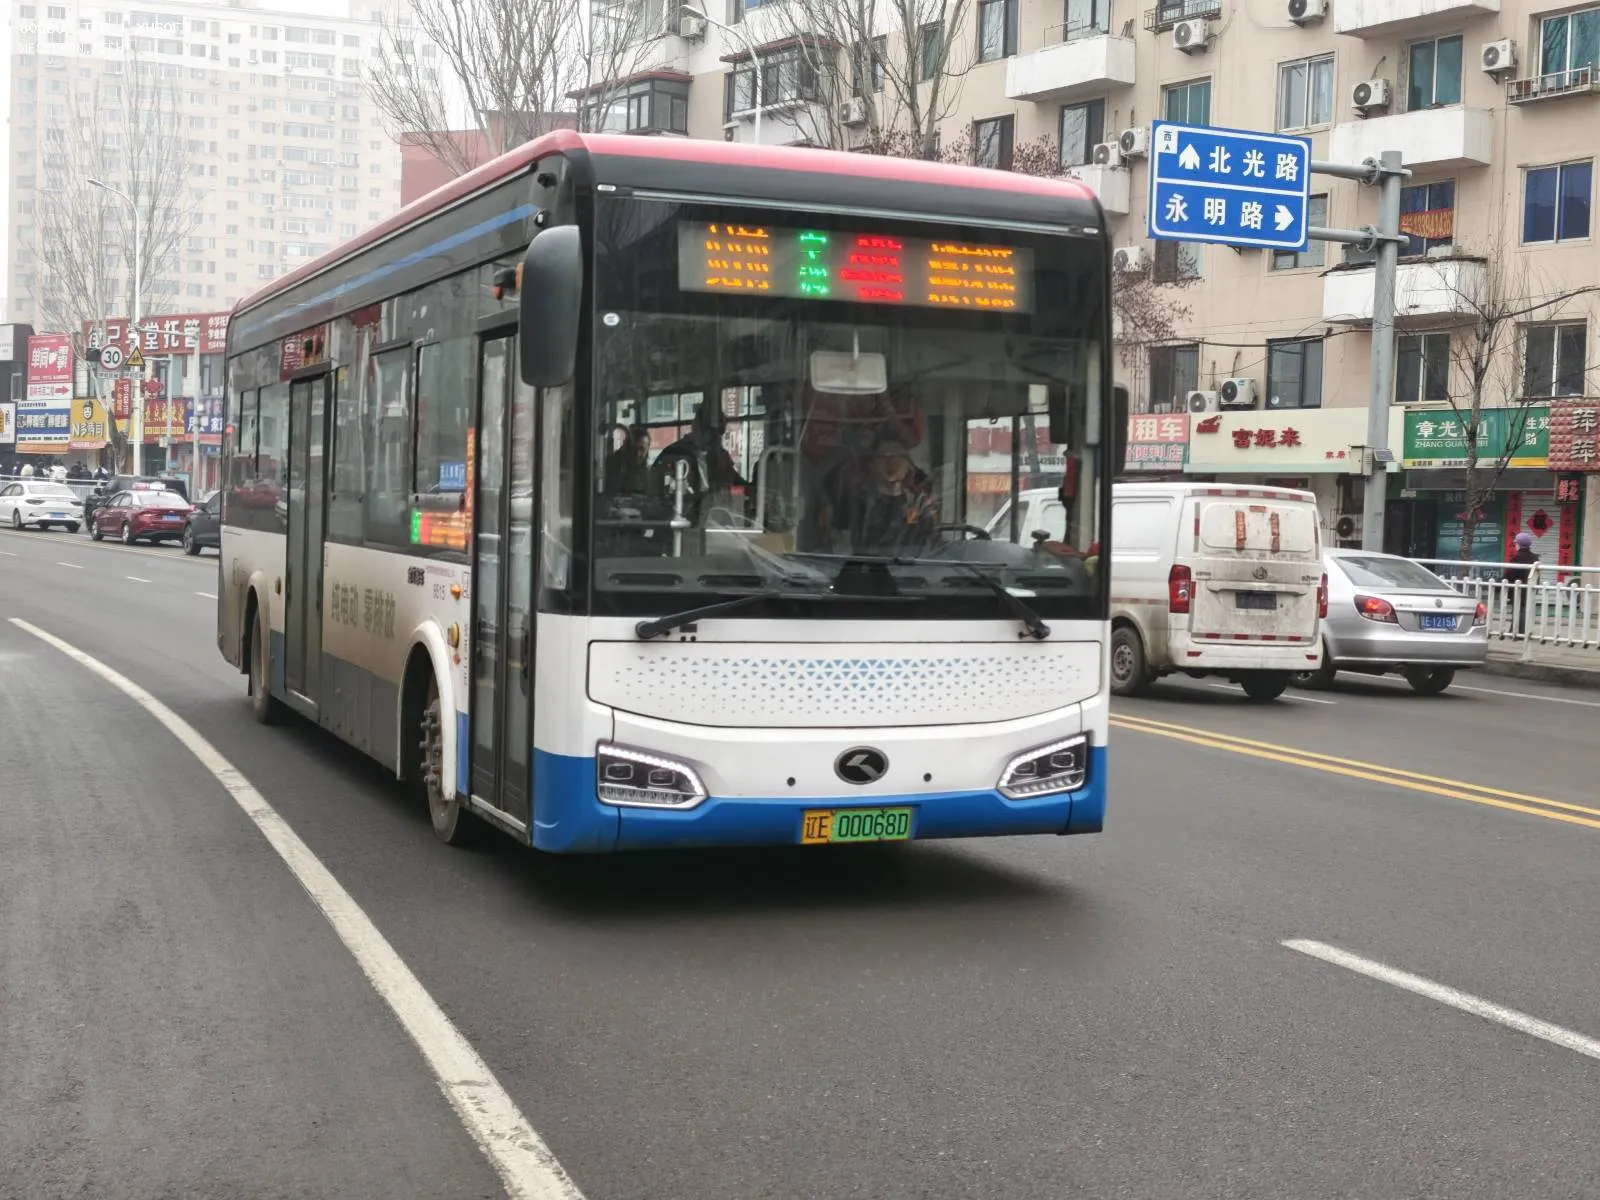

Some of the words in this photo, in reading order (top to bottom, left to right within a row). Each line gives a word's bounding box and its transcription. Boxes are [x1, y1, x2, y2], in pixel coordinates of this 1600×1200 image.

[1163, 131, 1172, 141] 西
[1208, 145, 1299, 182] 北光路
[1164, 193, 1264, 230] 永明路
[104, 351, 120, 364] 30
[1128, 418, 1184, 441] 租车
[1231, 427, 1303, 449] 富妮来
[1415, 420, 1488, 438] 章光11
[1414, 440, 1443, 448] ZHANG
